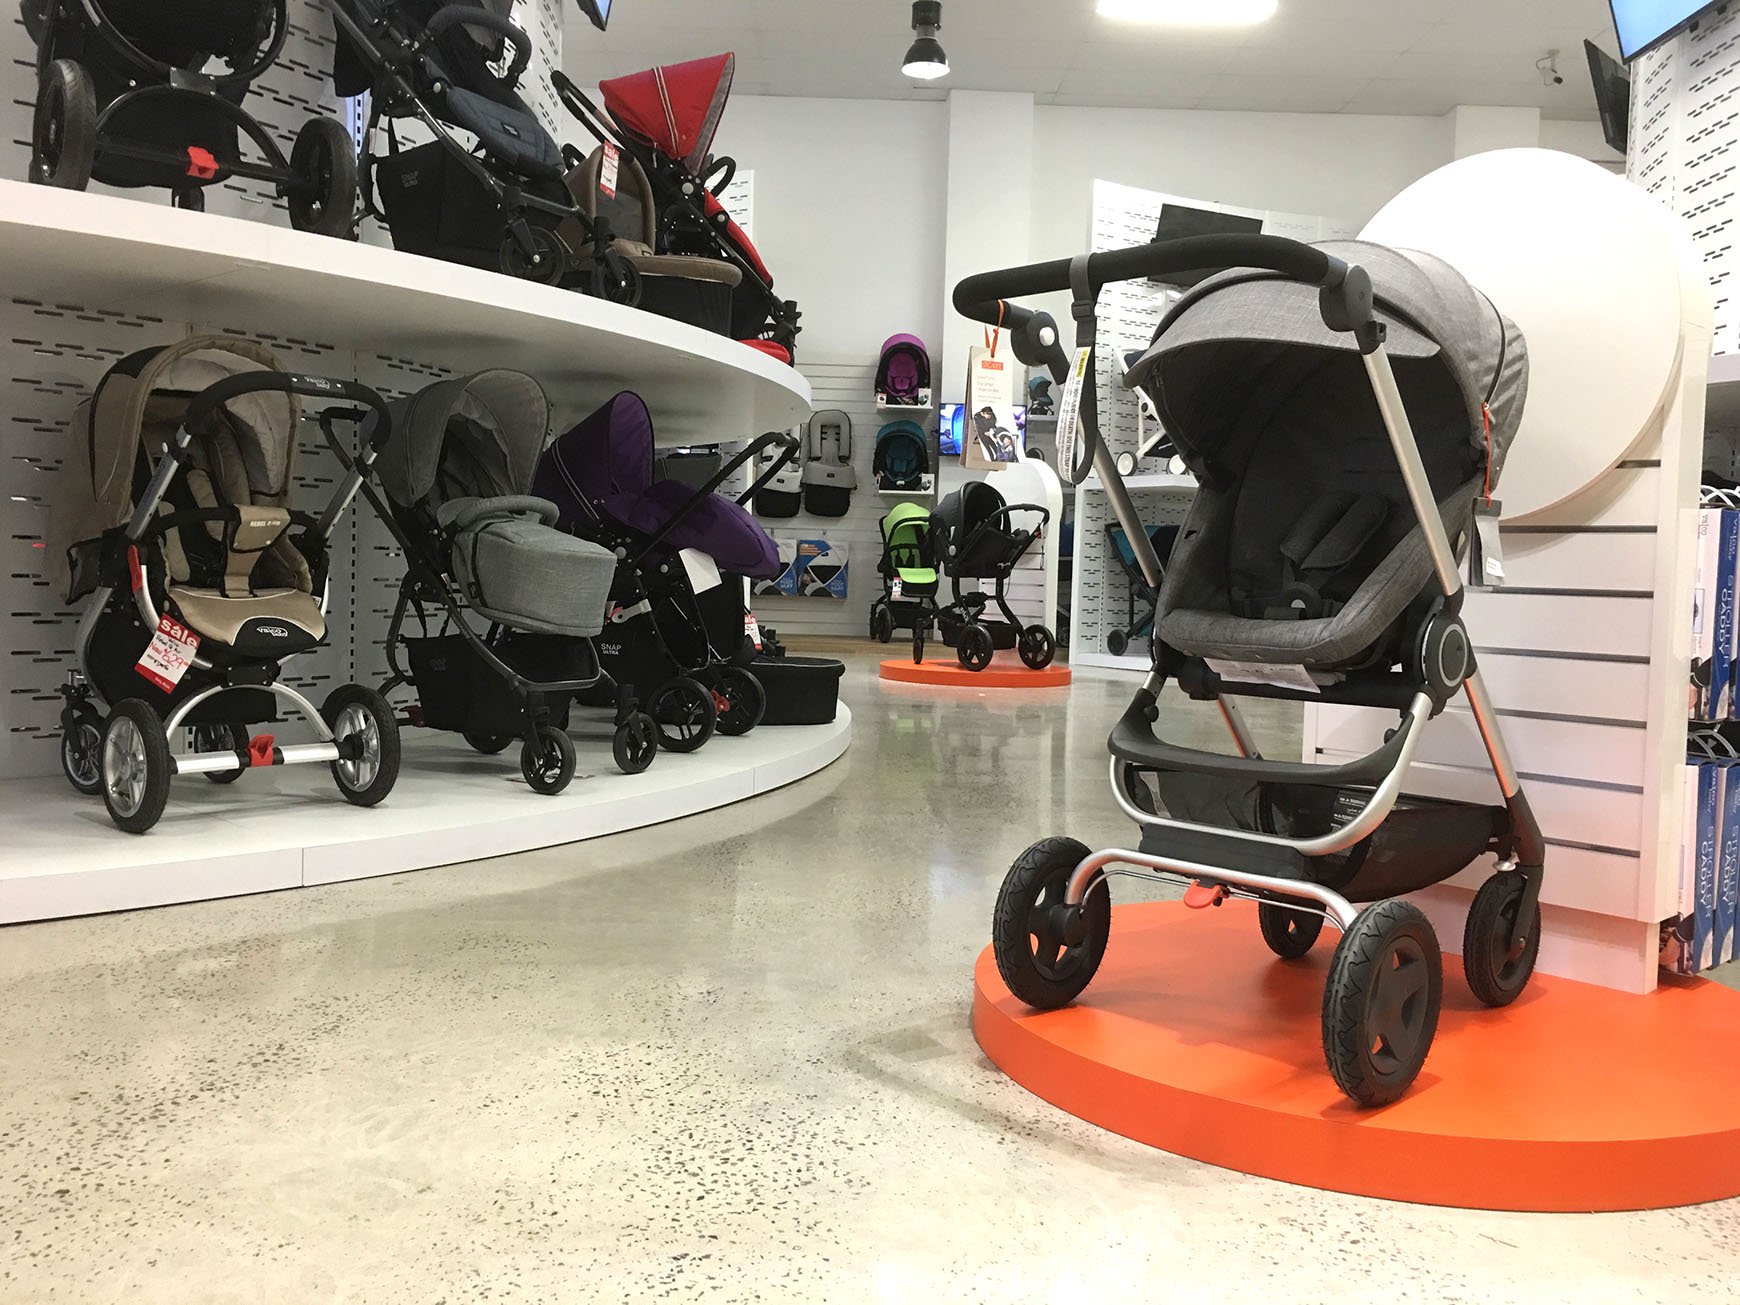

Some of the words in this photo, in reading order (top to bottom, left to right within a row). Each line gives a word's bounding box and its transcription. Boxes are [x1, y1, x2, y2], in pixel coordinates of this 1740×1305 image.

[1701, 514, 1709, 536] valco
[160, 619, 198, 649] sale
[601, 642, 622, 651] SNAP
[1719, 588, 1729, 654] CADDY
[1722, 574, 1735, 668] STROLLER
[1700, 840, 1709, 907] CADDY
[1705, 825, 1715, 918] STROLLER
[1721, 840, 1732, 904] CADDY
[1728, 824, 1739, 915] STROLLER
